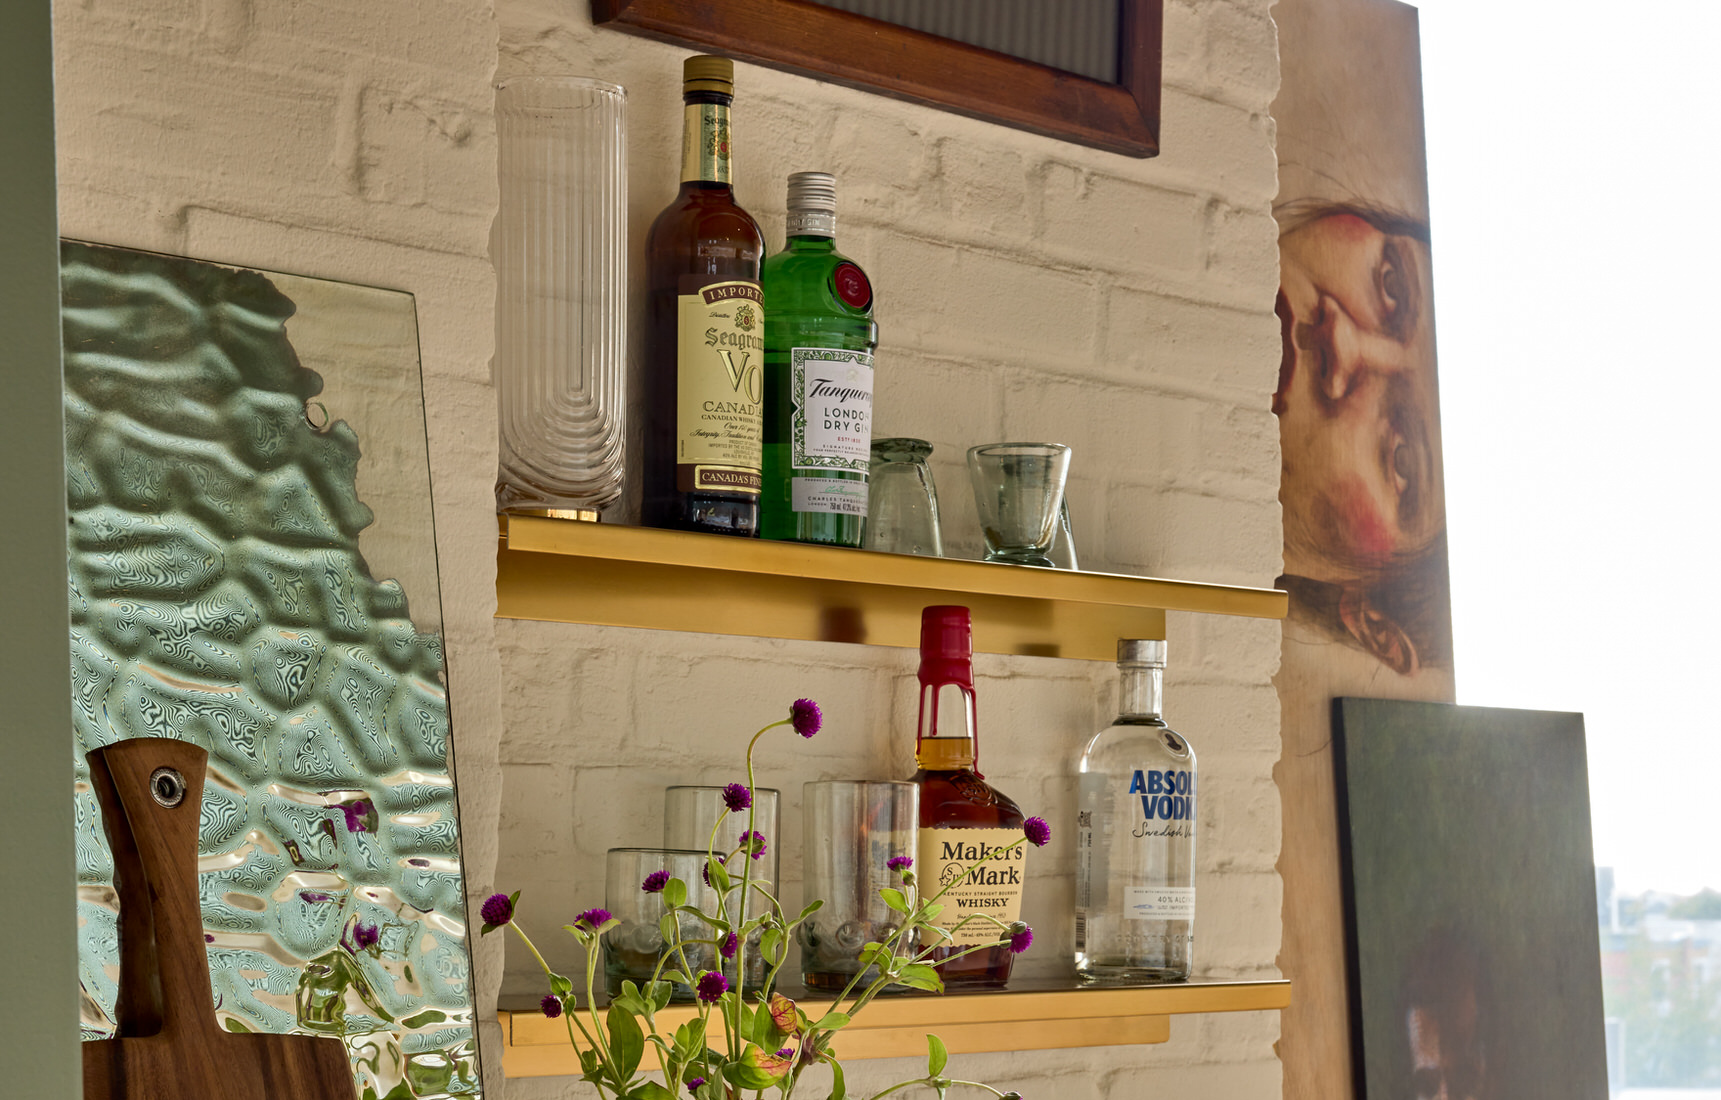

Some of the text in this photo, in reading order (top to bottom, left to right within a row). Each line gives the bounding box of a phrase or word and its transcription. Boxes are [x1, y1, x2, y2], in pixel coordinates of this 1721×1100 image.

[701, 414, 738, 422] CANADIAN
[823, 420, 850, 431] DRY
[702, 472, 749, 484] CANADA'S
[1129, 770, 1195, 795] ABSOL
[1141, 795, 1195, 820] VODK
[1132, 821, 1183, 838] Swedish
[939, 841, 1023, 861] Maker's
[965, 866, 1020, 886] Mark
[956, 897, 1009, 908] WHISKY
